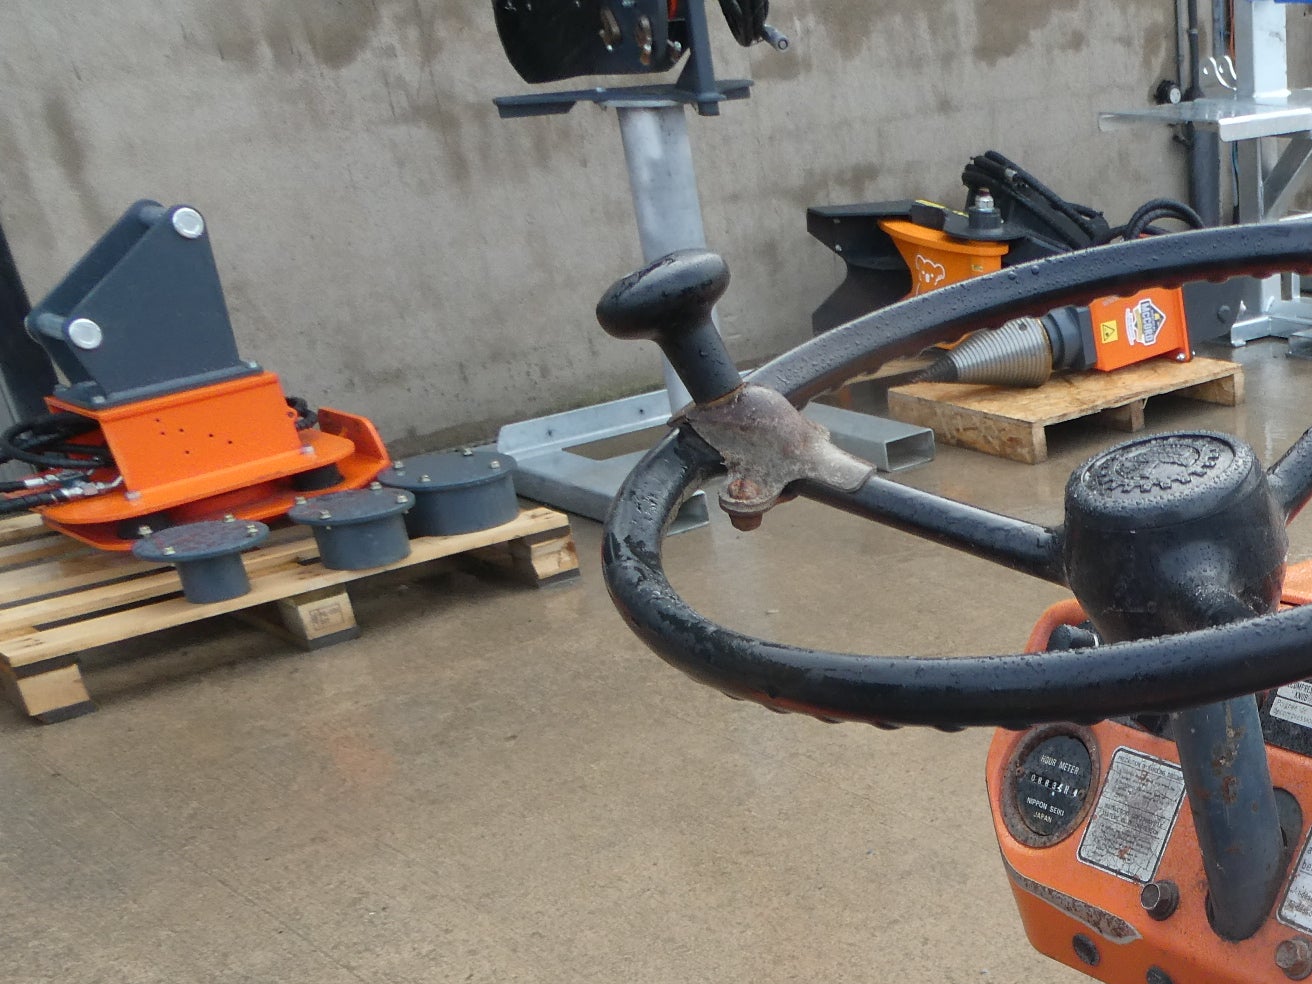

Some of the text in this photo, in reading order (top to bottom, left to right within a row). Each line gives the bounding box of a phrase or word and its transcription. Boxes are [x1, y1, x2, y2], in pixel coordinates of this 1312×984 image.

[1040, 754, 1080, 775] HOUR METER
[1026, 797, 1065, 817] NIPPON SEIKI
[1033, 811, 1053, 824] JAPAN
